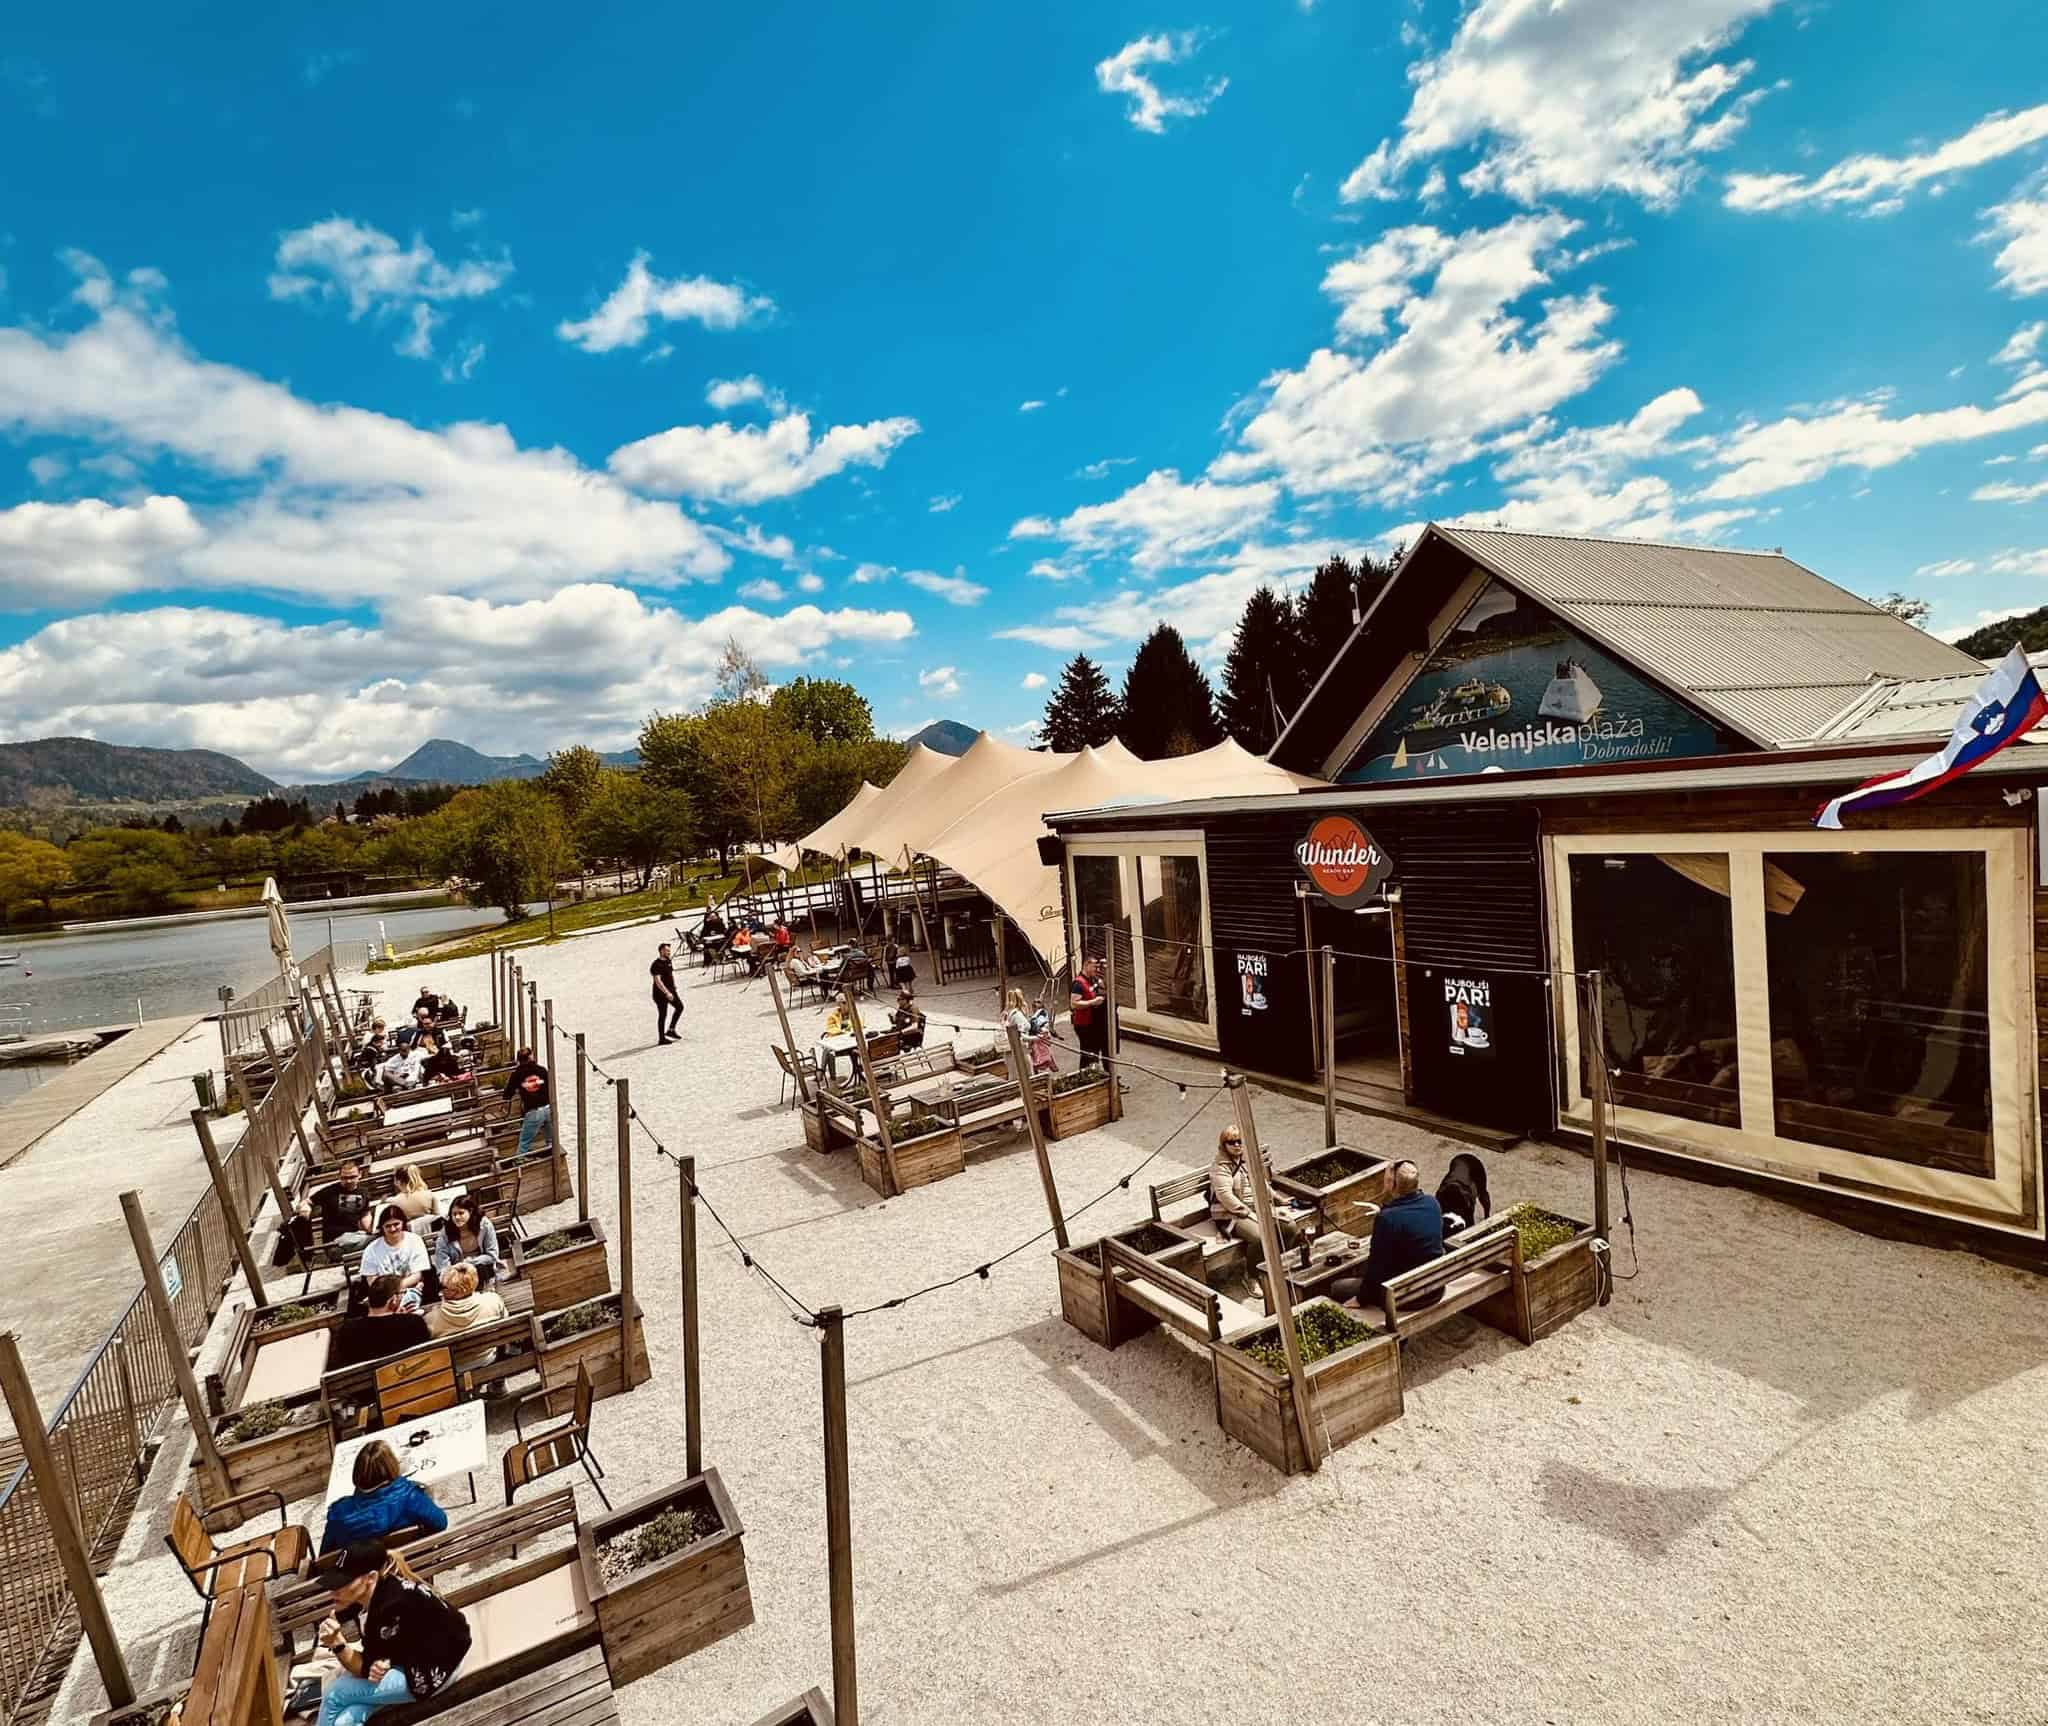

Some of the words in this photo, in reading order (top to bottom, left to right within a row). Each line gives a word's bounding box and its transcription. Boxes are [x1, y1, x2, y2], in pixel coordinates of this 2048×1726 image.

[1583, 737, 1673, 761] Dobrodošli!
[1297, 841, 1381, 866] Wunder
[1238, 960, 1268, 977] PAR!
[1445, 985, 1491, 1008] PAR!
